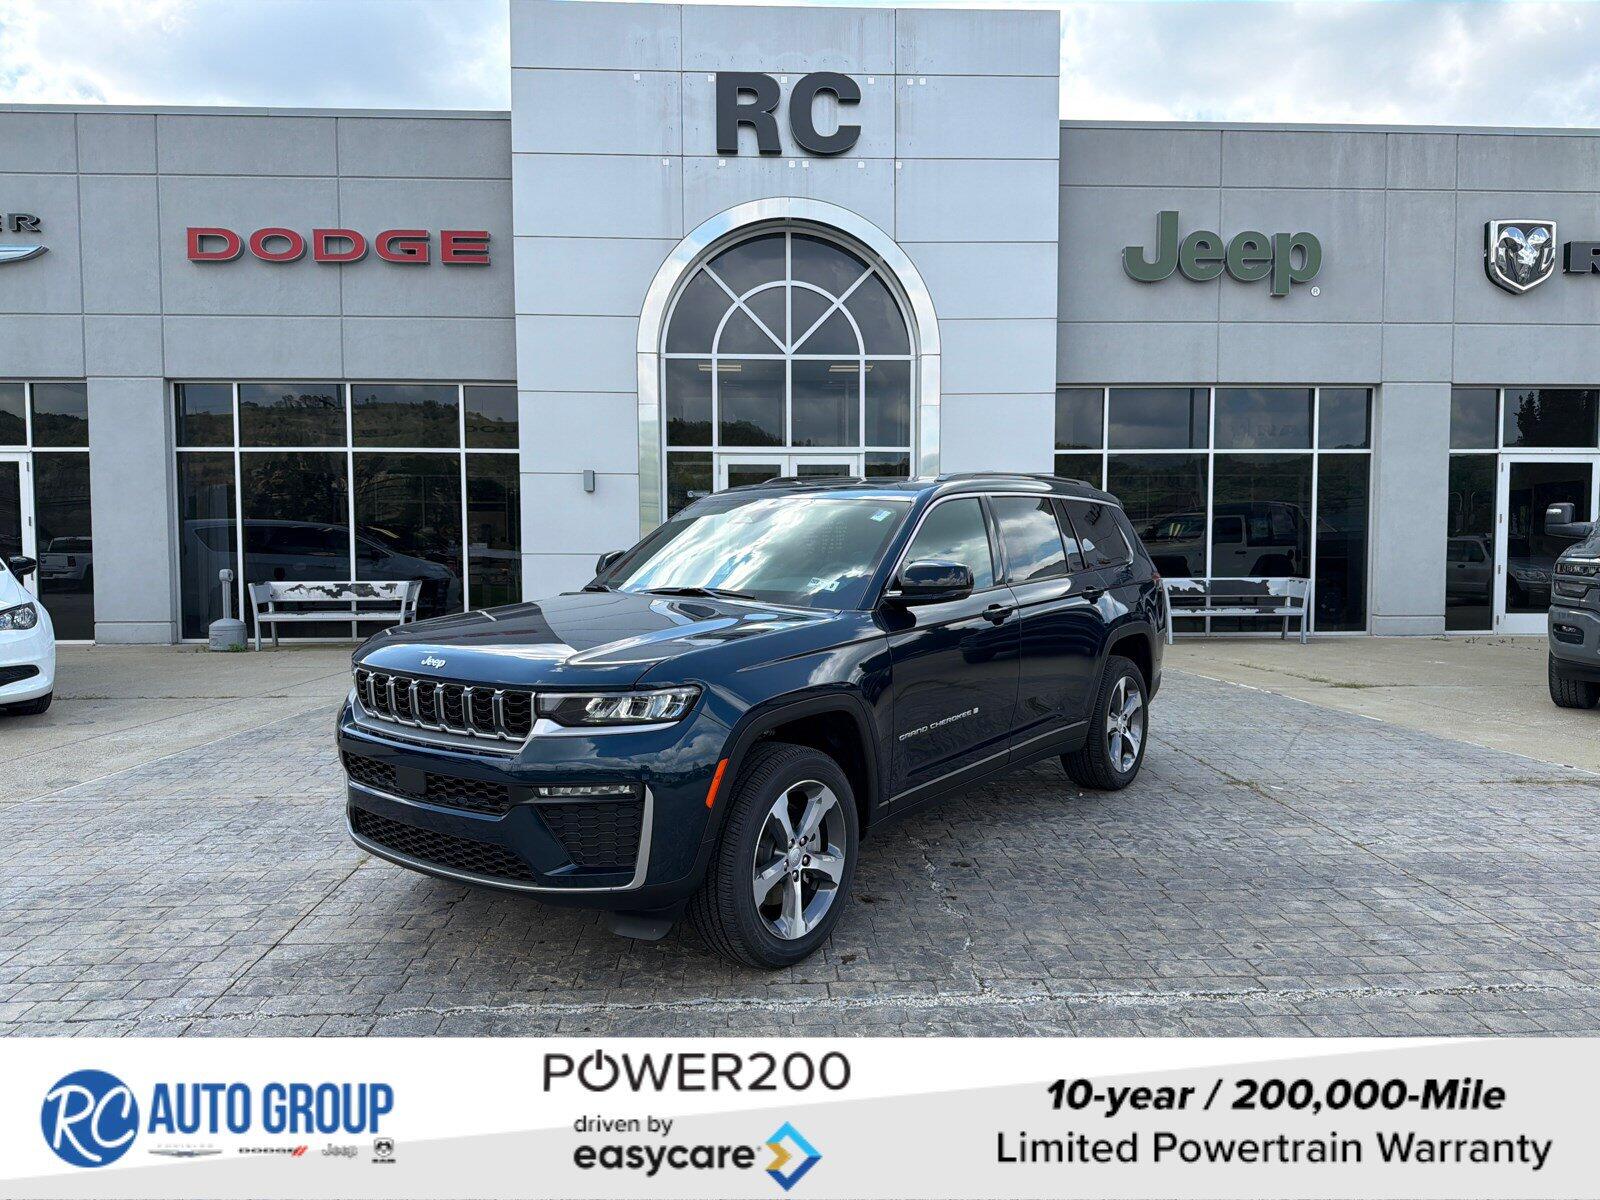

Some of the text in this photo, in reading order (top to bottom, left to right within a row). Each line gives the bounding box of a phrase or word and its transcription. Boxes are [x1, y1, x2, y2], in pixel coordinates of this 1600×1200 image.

[716, 71, 862, 156] RC
[186, 226, 492, 266] DODGE
[1122, 211, 1322, 297] Jeep
[421, 656, 446, 669] Jeep
[899, 709, 973, 741] GRAND CHEROKEE
